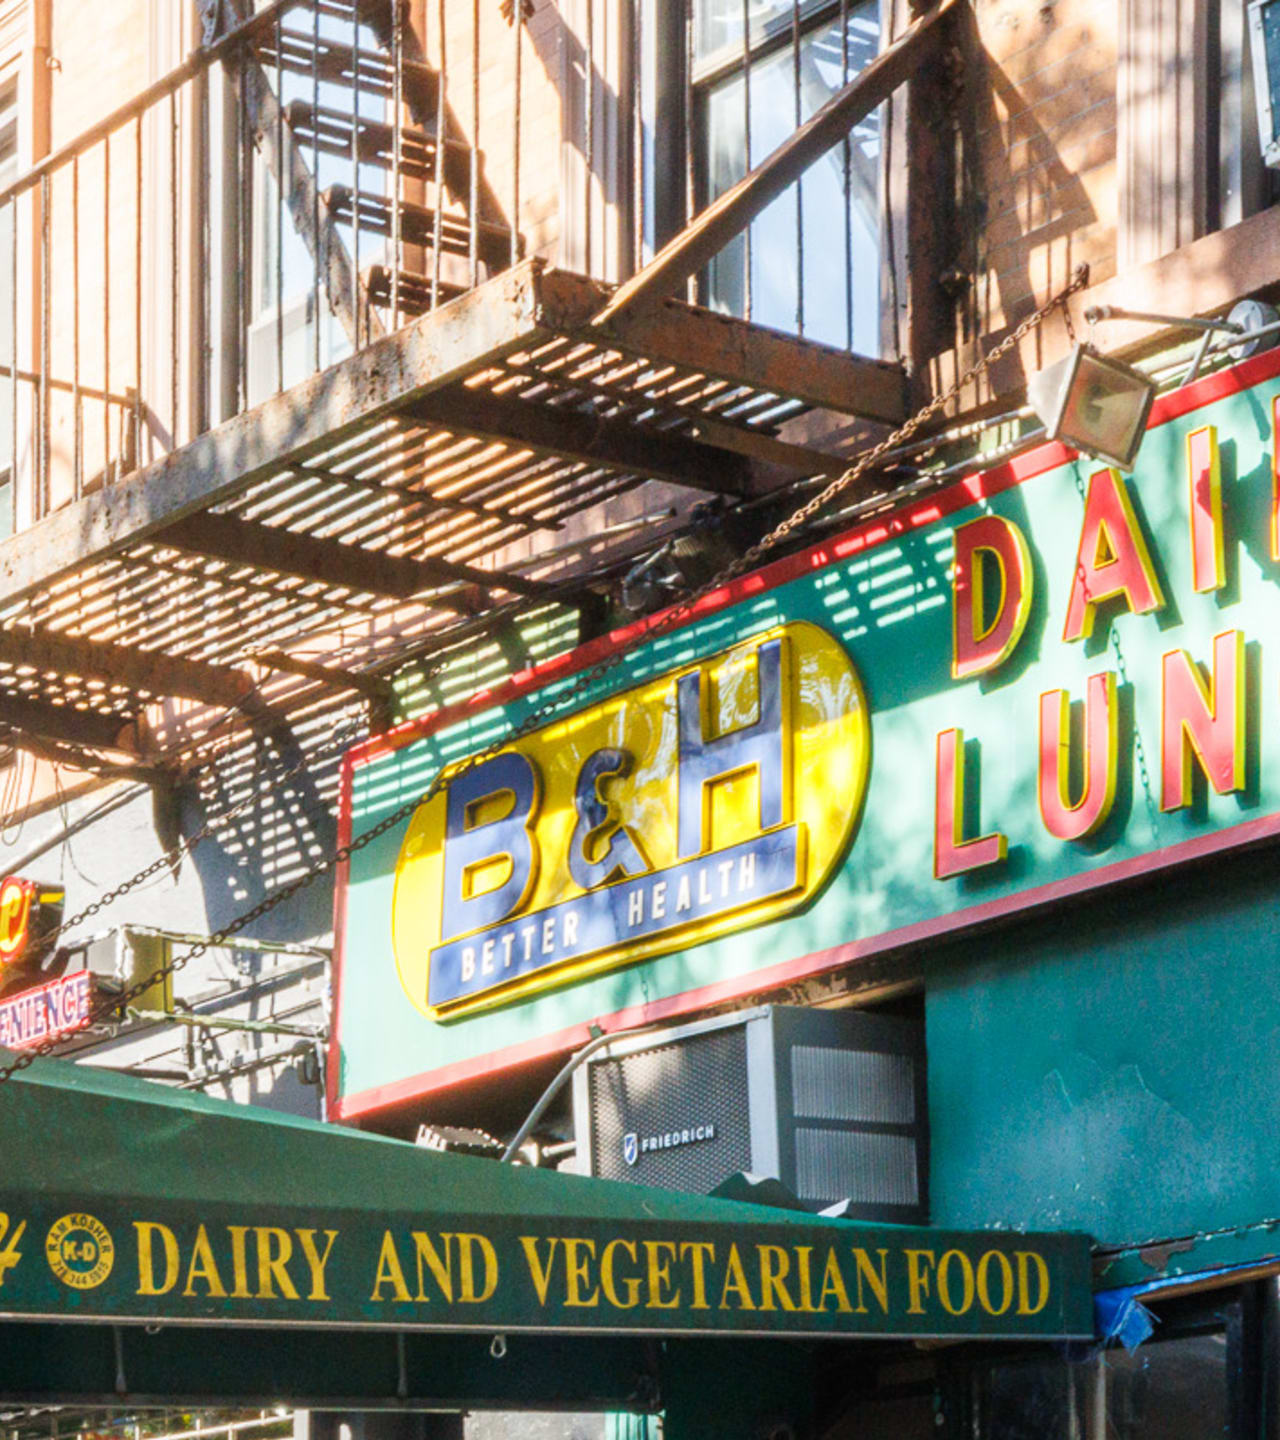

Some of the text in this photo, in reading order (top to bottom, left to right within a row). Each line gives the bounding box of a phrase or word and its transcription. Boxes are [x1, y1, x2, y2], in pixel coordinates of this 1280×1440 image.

[460, 851, 759, 983] BETTER HEALTH
[642, 1125, 714, 1152] FRIEDRICH
[63, 1241, 96, 1261] K-D
[70, 1215, 112, 1253] KOSHER
[132, 1221, 1050, 1317] DAIRY AND VEGETARIAN FOOD
